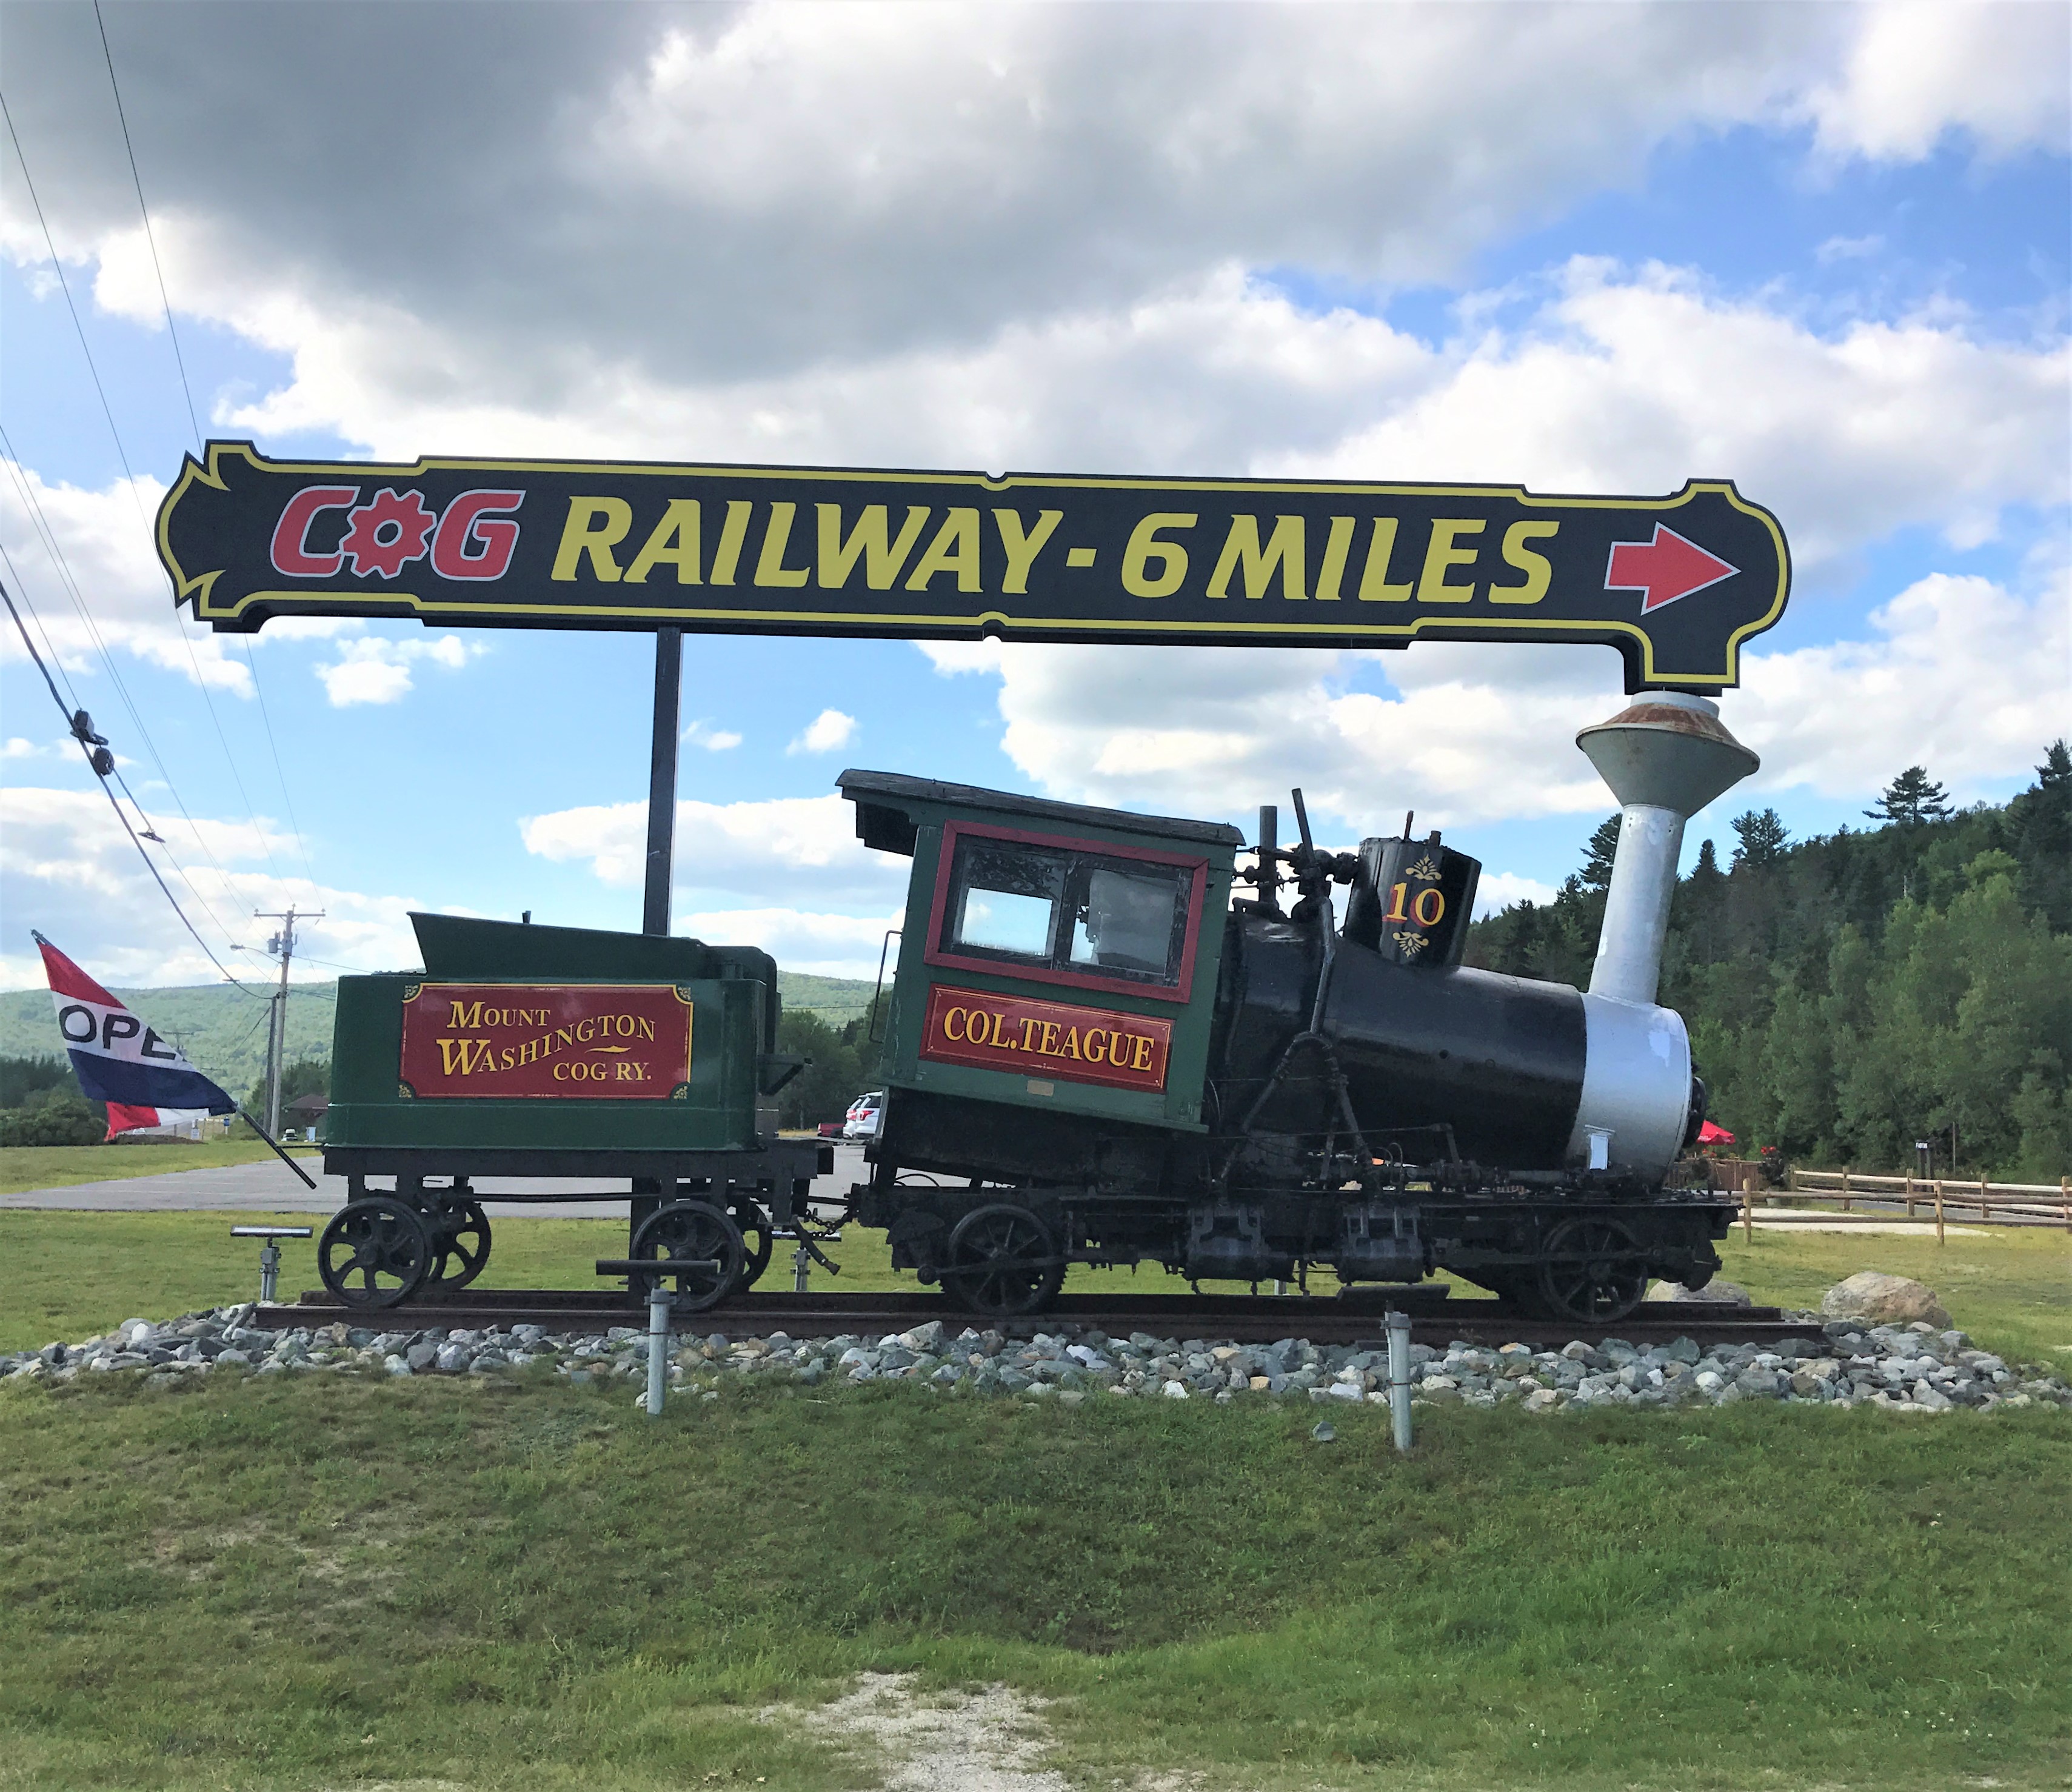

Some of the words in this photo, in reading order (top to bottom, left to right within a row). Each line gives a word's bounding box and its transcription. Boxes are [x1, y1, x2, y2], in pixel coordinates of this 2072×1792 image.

[552, 496, 1063, 593] RAILWAY
[1122, 513, 1197, 598] 6
[1206, 515, 1559, 604] MILES
[1382, 883, 1445, 926] 10
[59, 1005, 187, 1061] OPE
[447, 1001, 550, 1028] MOUNT
[436, 1014, 656, 1075] WASHINGTON
[553, 1062, 607, 1081] COG
[616, 1062, 652, 1082] RY.
